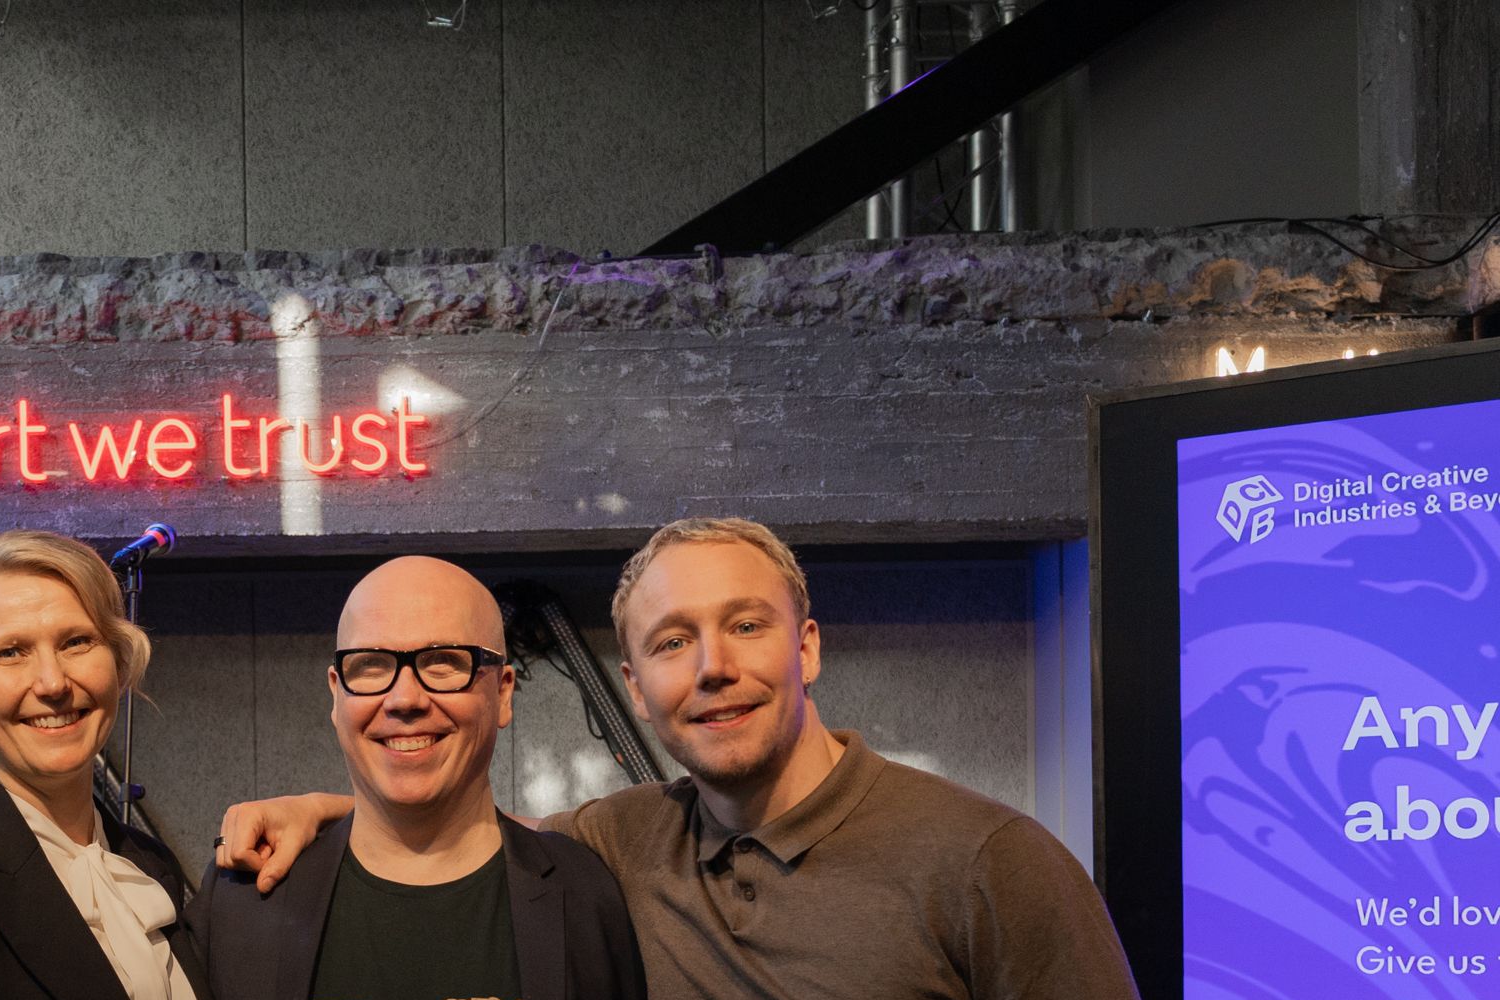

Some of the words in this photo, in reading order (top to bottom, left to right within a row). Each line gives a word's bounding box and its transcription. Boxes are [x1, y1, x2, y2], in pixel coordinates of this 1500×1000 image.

[68, 417, 198, 480] we
[222, 393, 427, 477] trust
[1293, 475, 1373, 503] Digital
[1382, 465, 1490, 493] Creative
[1294, 500, 1417, 528] Industries
[1424, 494, 1442, 515] &
[1449, 491, 1500, 513] Bey
[1342, 696, 1499, 760] Any
[1344, 785, 1500, 842] abo
[1356, 945, 1437, 975] Give
[1448, 954, 1487, 975] us
